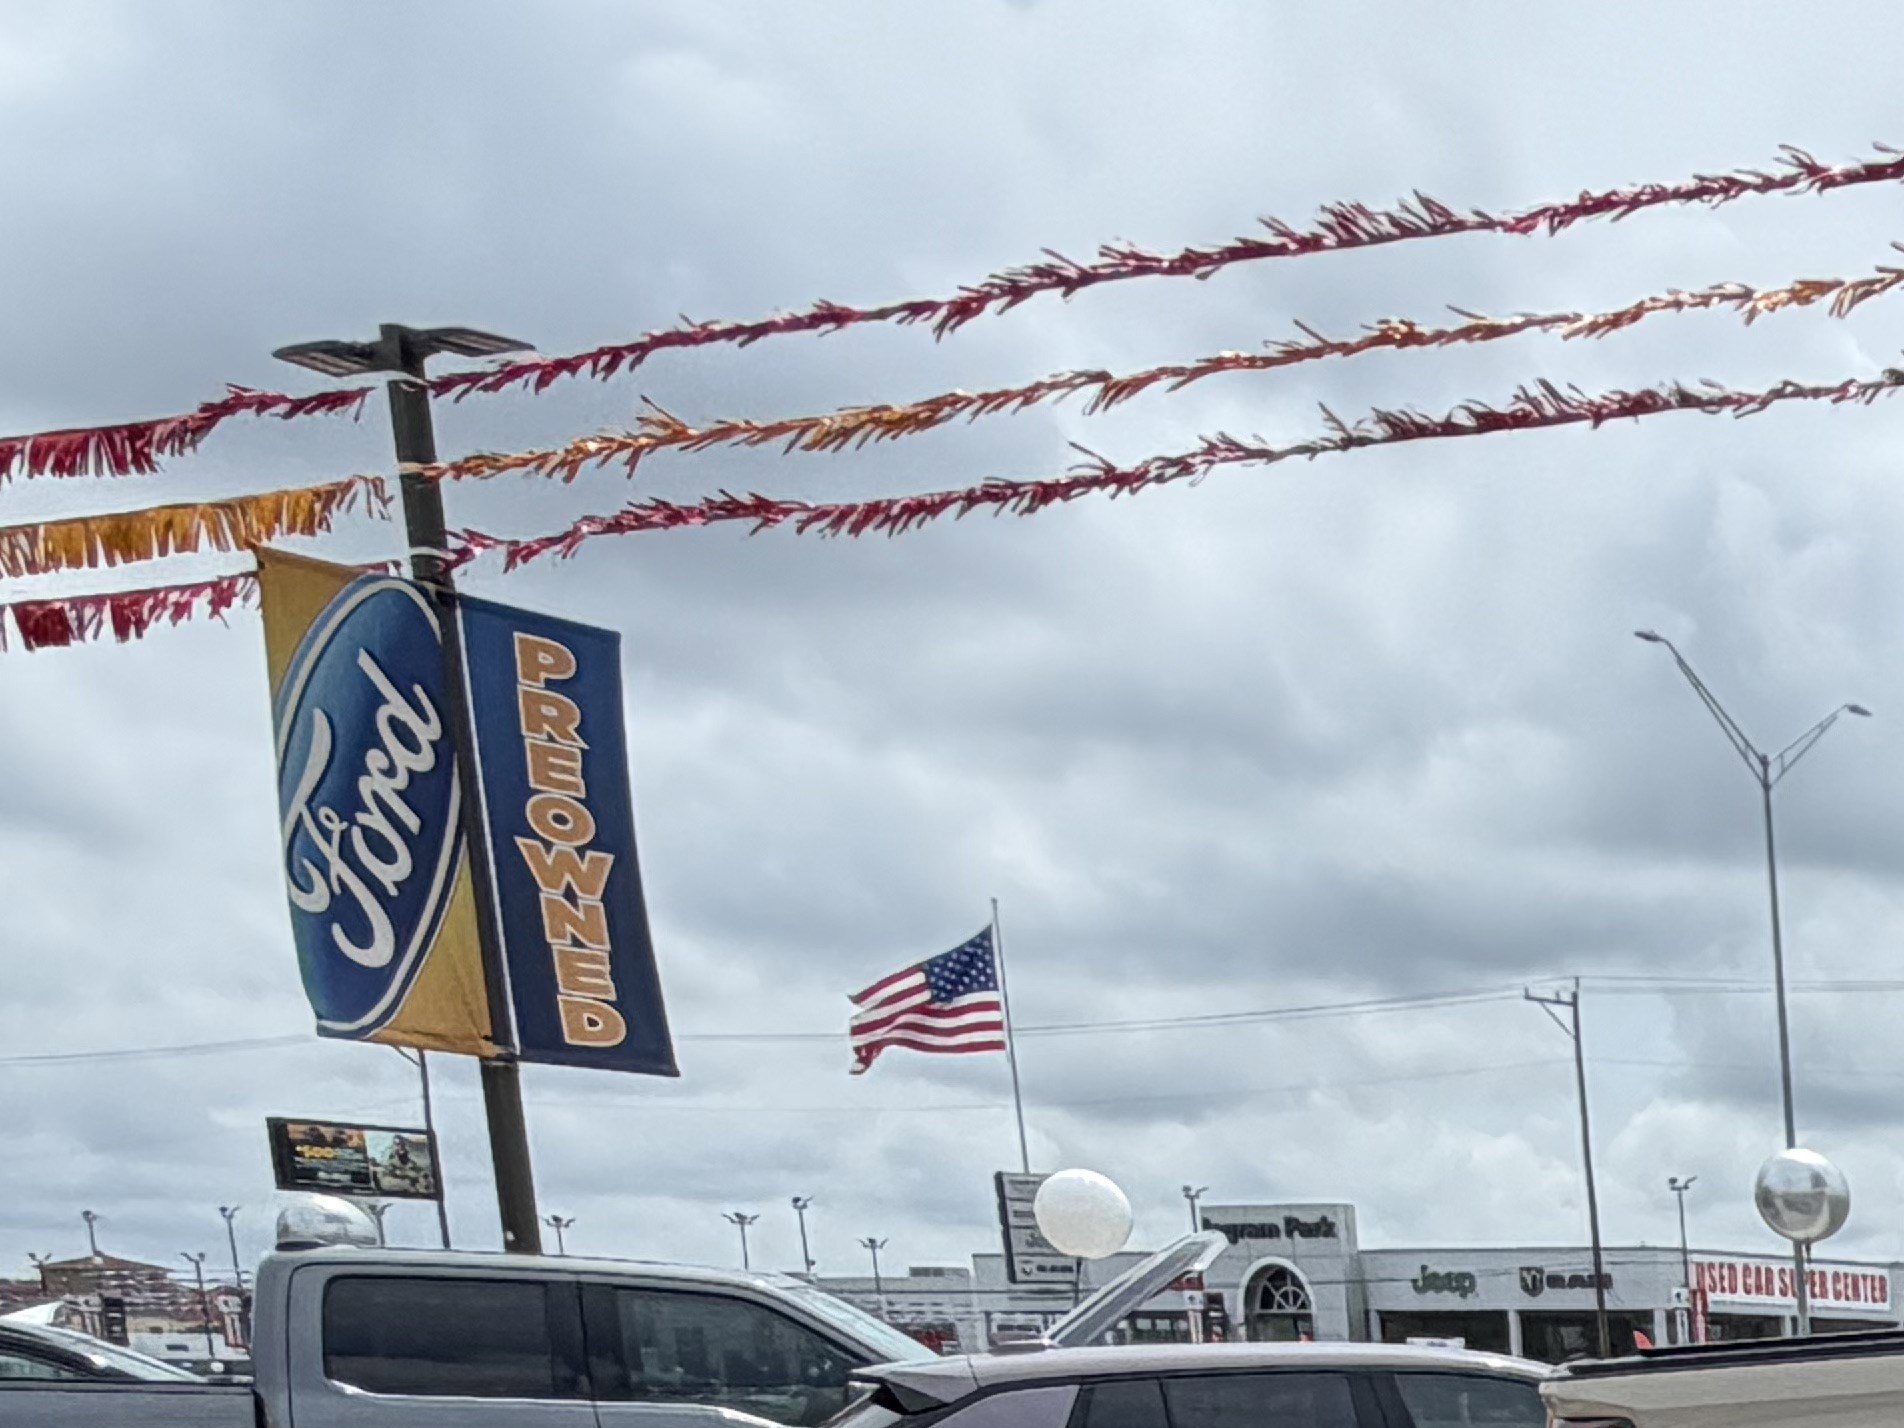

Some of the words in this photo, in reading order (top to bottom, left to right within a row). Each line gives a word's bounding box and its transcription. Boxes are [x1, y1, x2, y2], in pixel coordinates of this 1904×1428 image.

[283, 647, 443, 969] Ford
[512, 631, 627, 1047] PREOWNED
[1283, 1215, 1338, 1240] Park
[1411, 1264, 1477, 1298] Jeep
[1695, 1262, 1737, 1294] USED
[1742, 1262, 1775, 1296] CAR
[1832, 1269, 1888, 1304] CENTER
